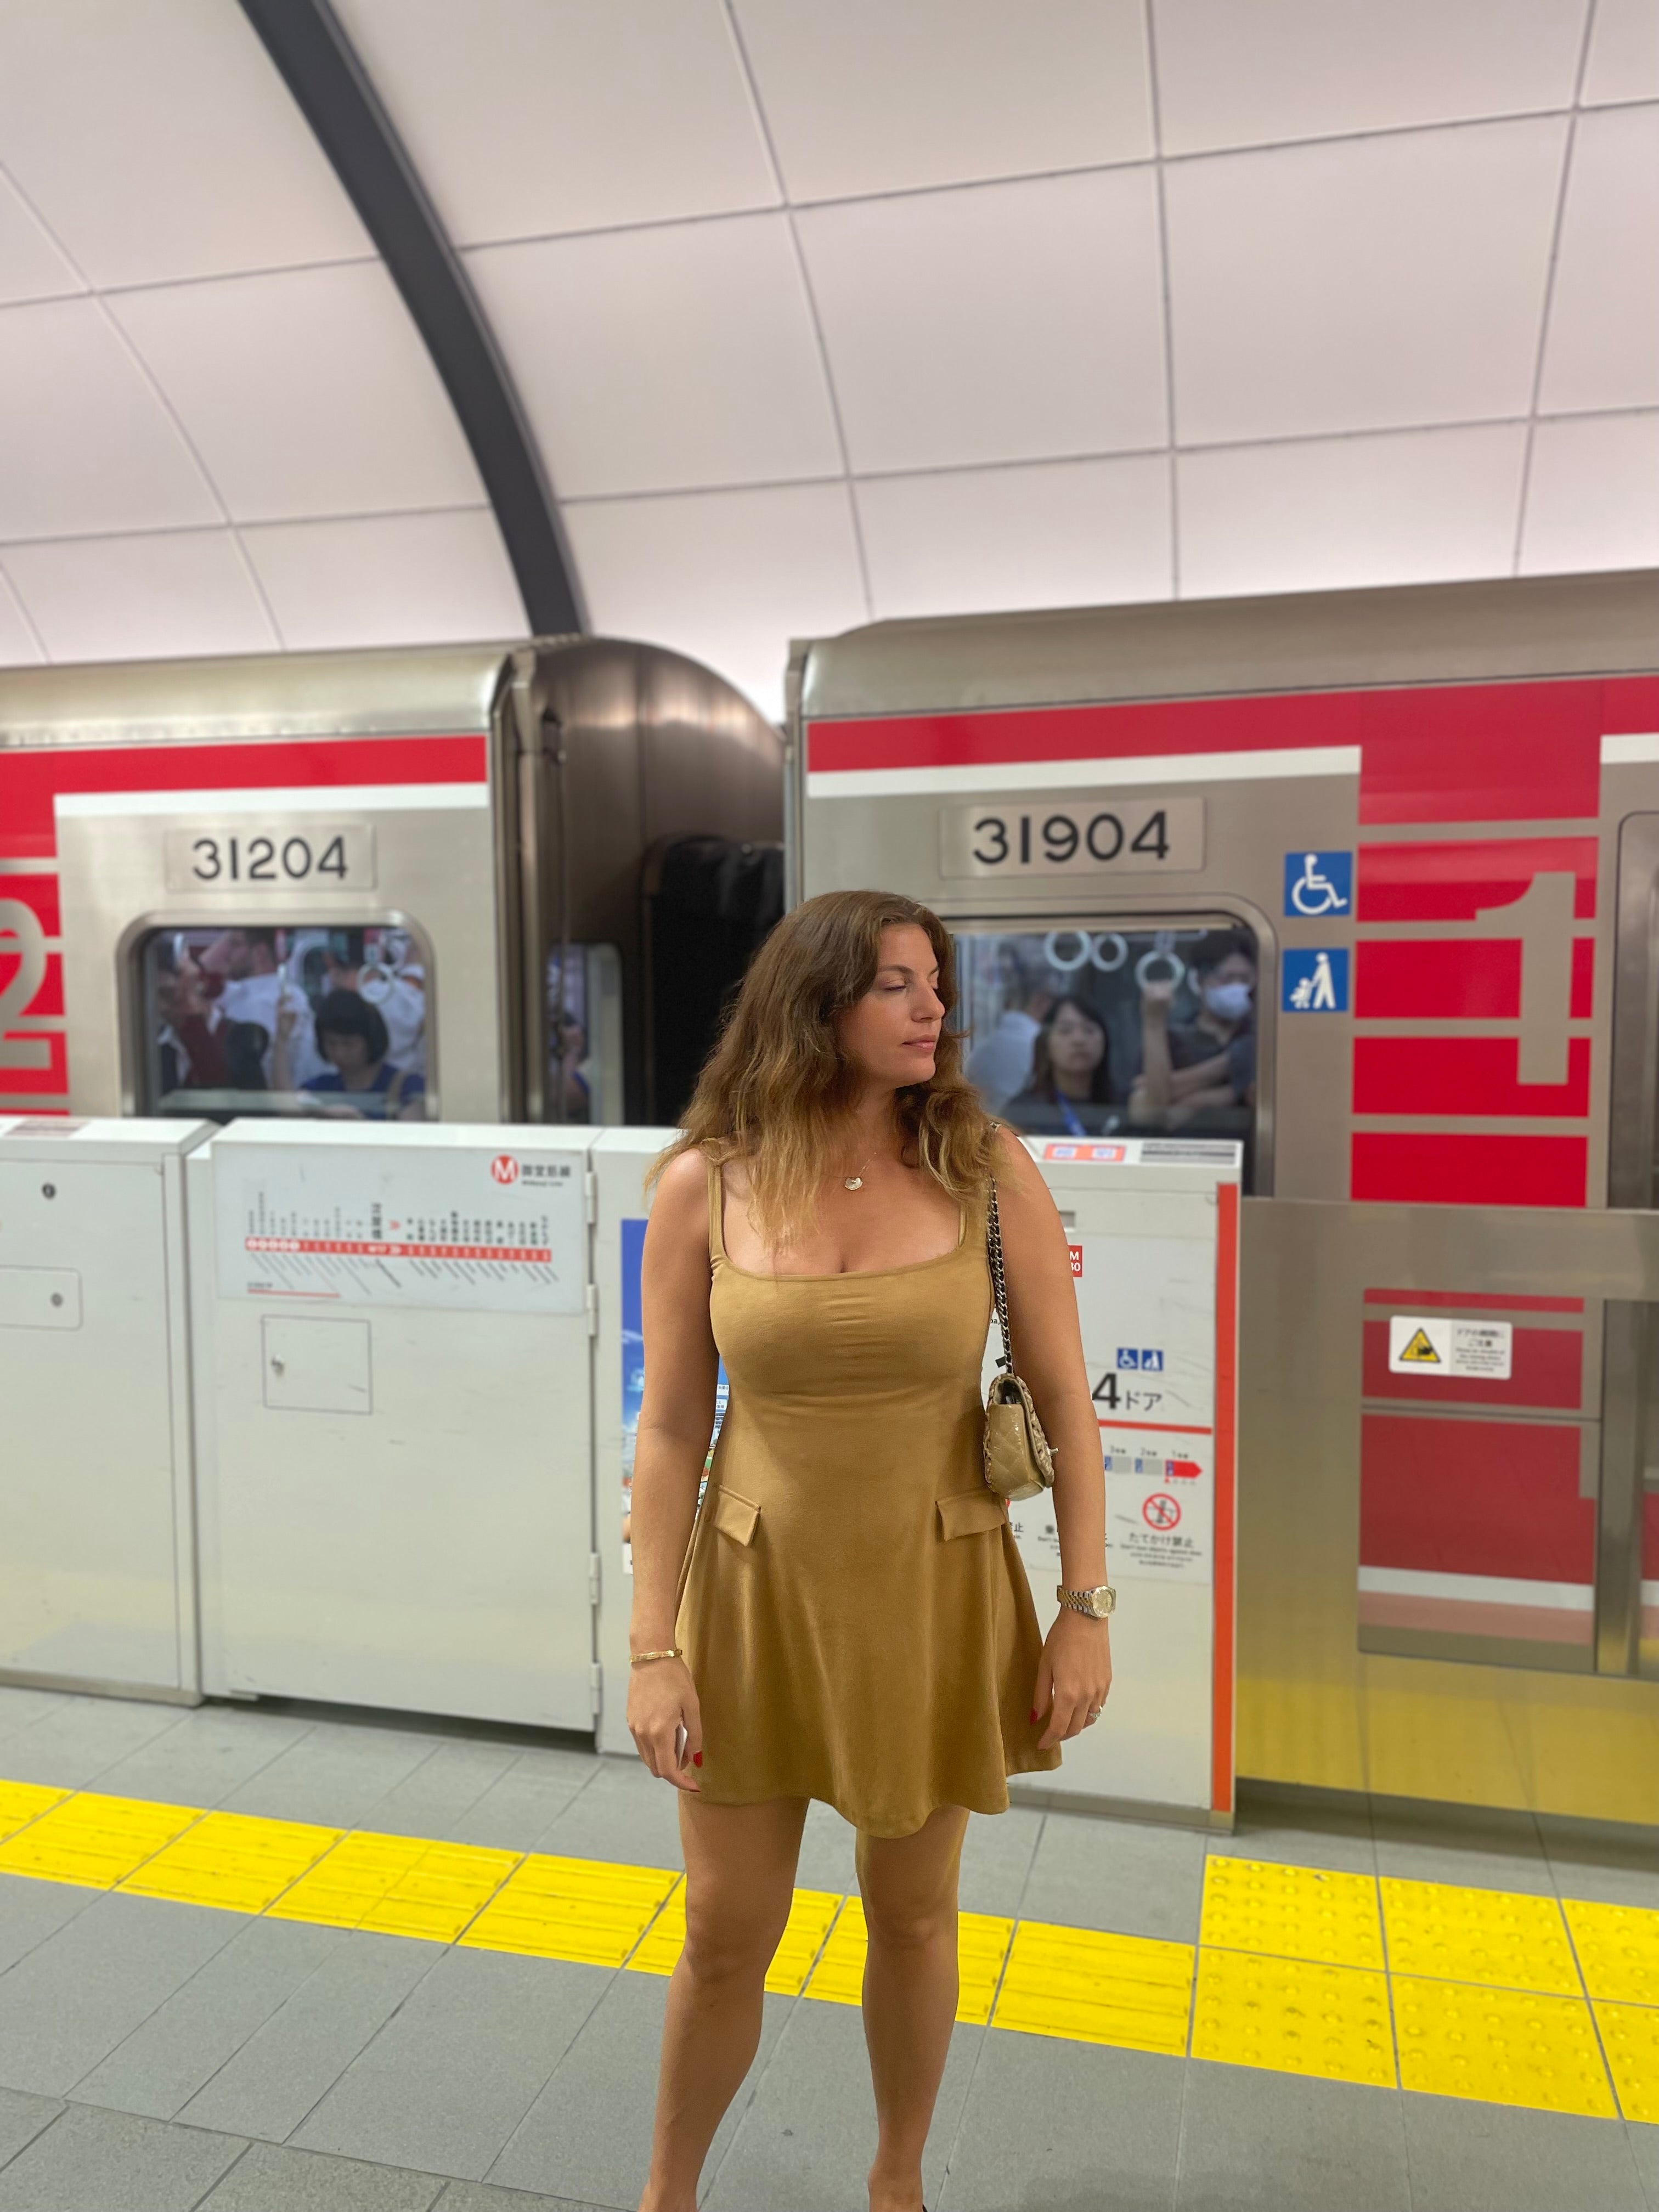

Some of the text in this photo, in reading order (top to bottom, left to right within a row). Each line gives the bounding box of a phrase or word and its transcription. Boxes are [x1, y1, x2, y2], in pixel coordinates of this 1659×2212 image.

[193, 836, 348, 881] 31204
[973, 811, 1170, 864] 31904
[1475, 871, 1576, 1085] 1
[1069, 1251, 1079, 1261] M
